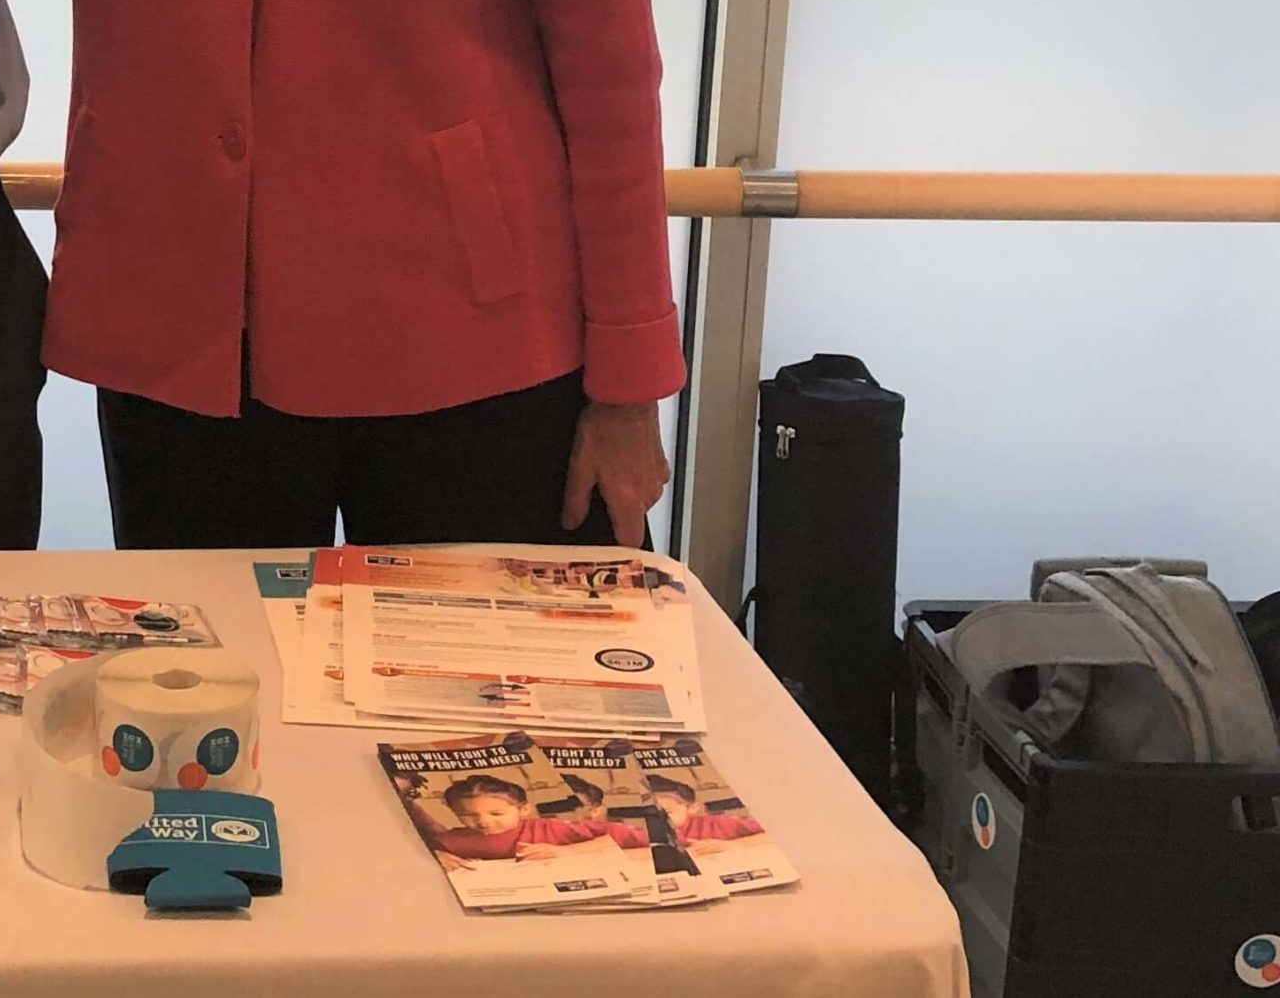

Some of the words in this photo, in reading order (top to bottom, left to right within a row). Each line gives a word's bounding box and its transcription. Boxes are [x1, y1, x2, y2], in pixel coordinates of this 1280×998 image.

[390, 752, 419, 762] WHO
[421, 751, 451, 761] WILL
[455, 749, 488, 760] FIGHT
[489, 746, 508, 756] TO
[550, 749, 585, 758] FIGHT
[588, 749, 605, 758] TO
[634, 750, 661, 759] GHT
[662, 749, 678, 758] TO
[396, 761, 425, 771] HELP
[428, 759, 472, 770] PEOPLE
[473, 757, 489, 767] IN
[491, 753, 526, 765] NEED?
[567, 758, 580, 767] IN
[583, 757, 622, 767] NEED?
[643, 758, 658, 767] IN
[660, 757, 698, 766] NEED?
[150, 827, 199, 840] Way
